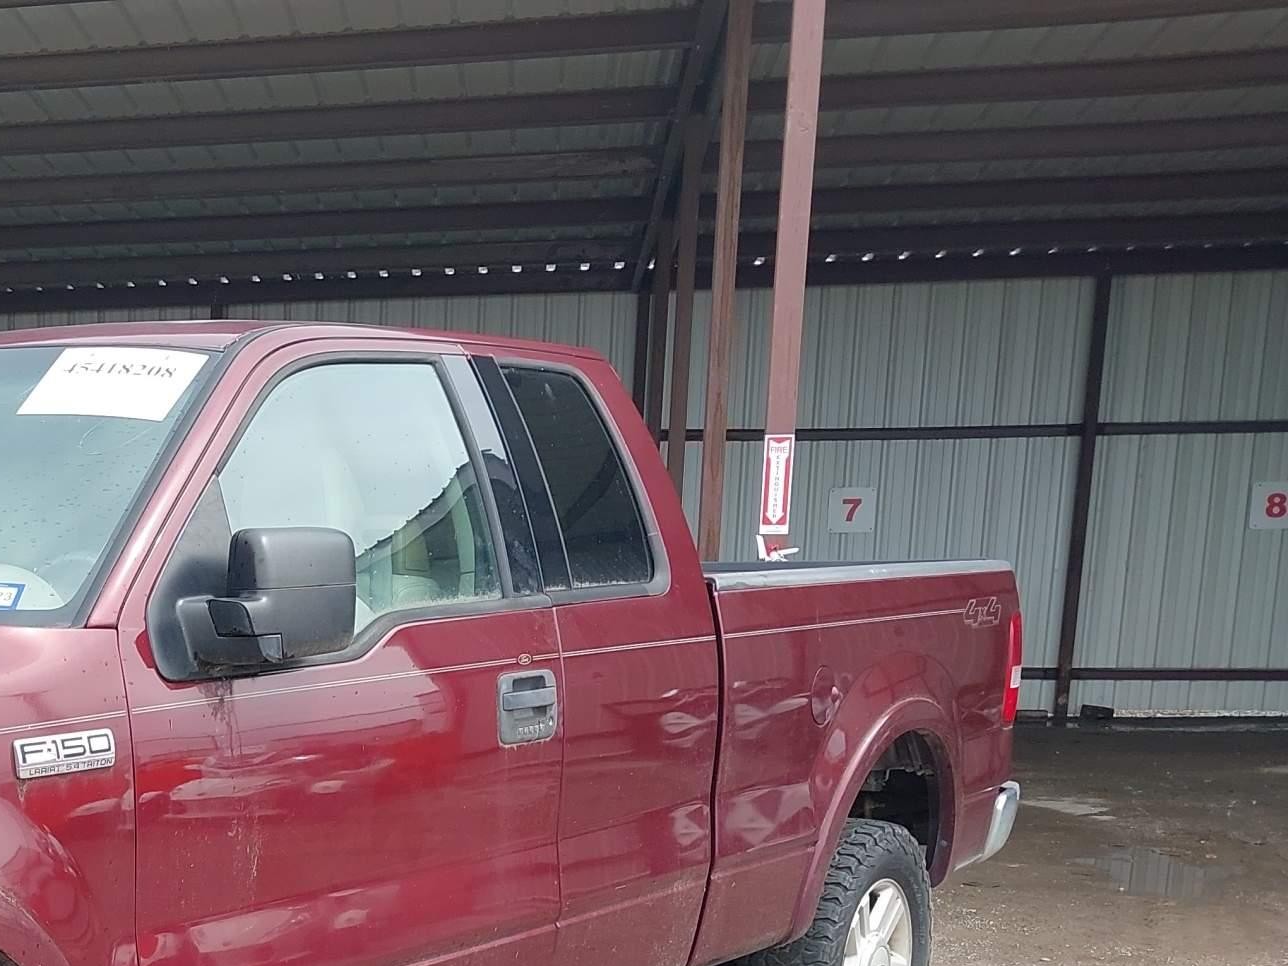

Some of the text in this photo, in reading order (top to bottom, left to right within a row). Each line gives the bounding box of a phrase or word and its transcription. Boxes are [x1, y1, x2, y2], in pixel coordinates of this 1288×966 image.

[64, 362, 177, 378] 45418208
[770, 446, 788, 454] FIRE
[842, 498, 863, 522] 7
[1265, 493, 1287, 518] 8
[19, 734, 112, 764] F-150
[29, 765, 62, 776] LARIAT
[81, 758, 113, 769] TRITON
